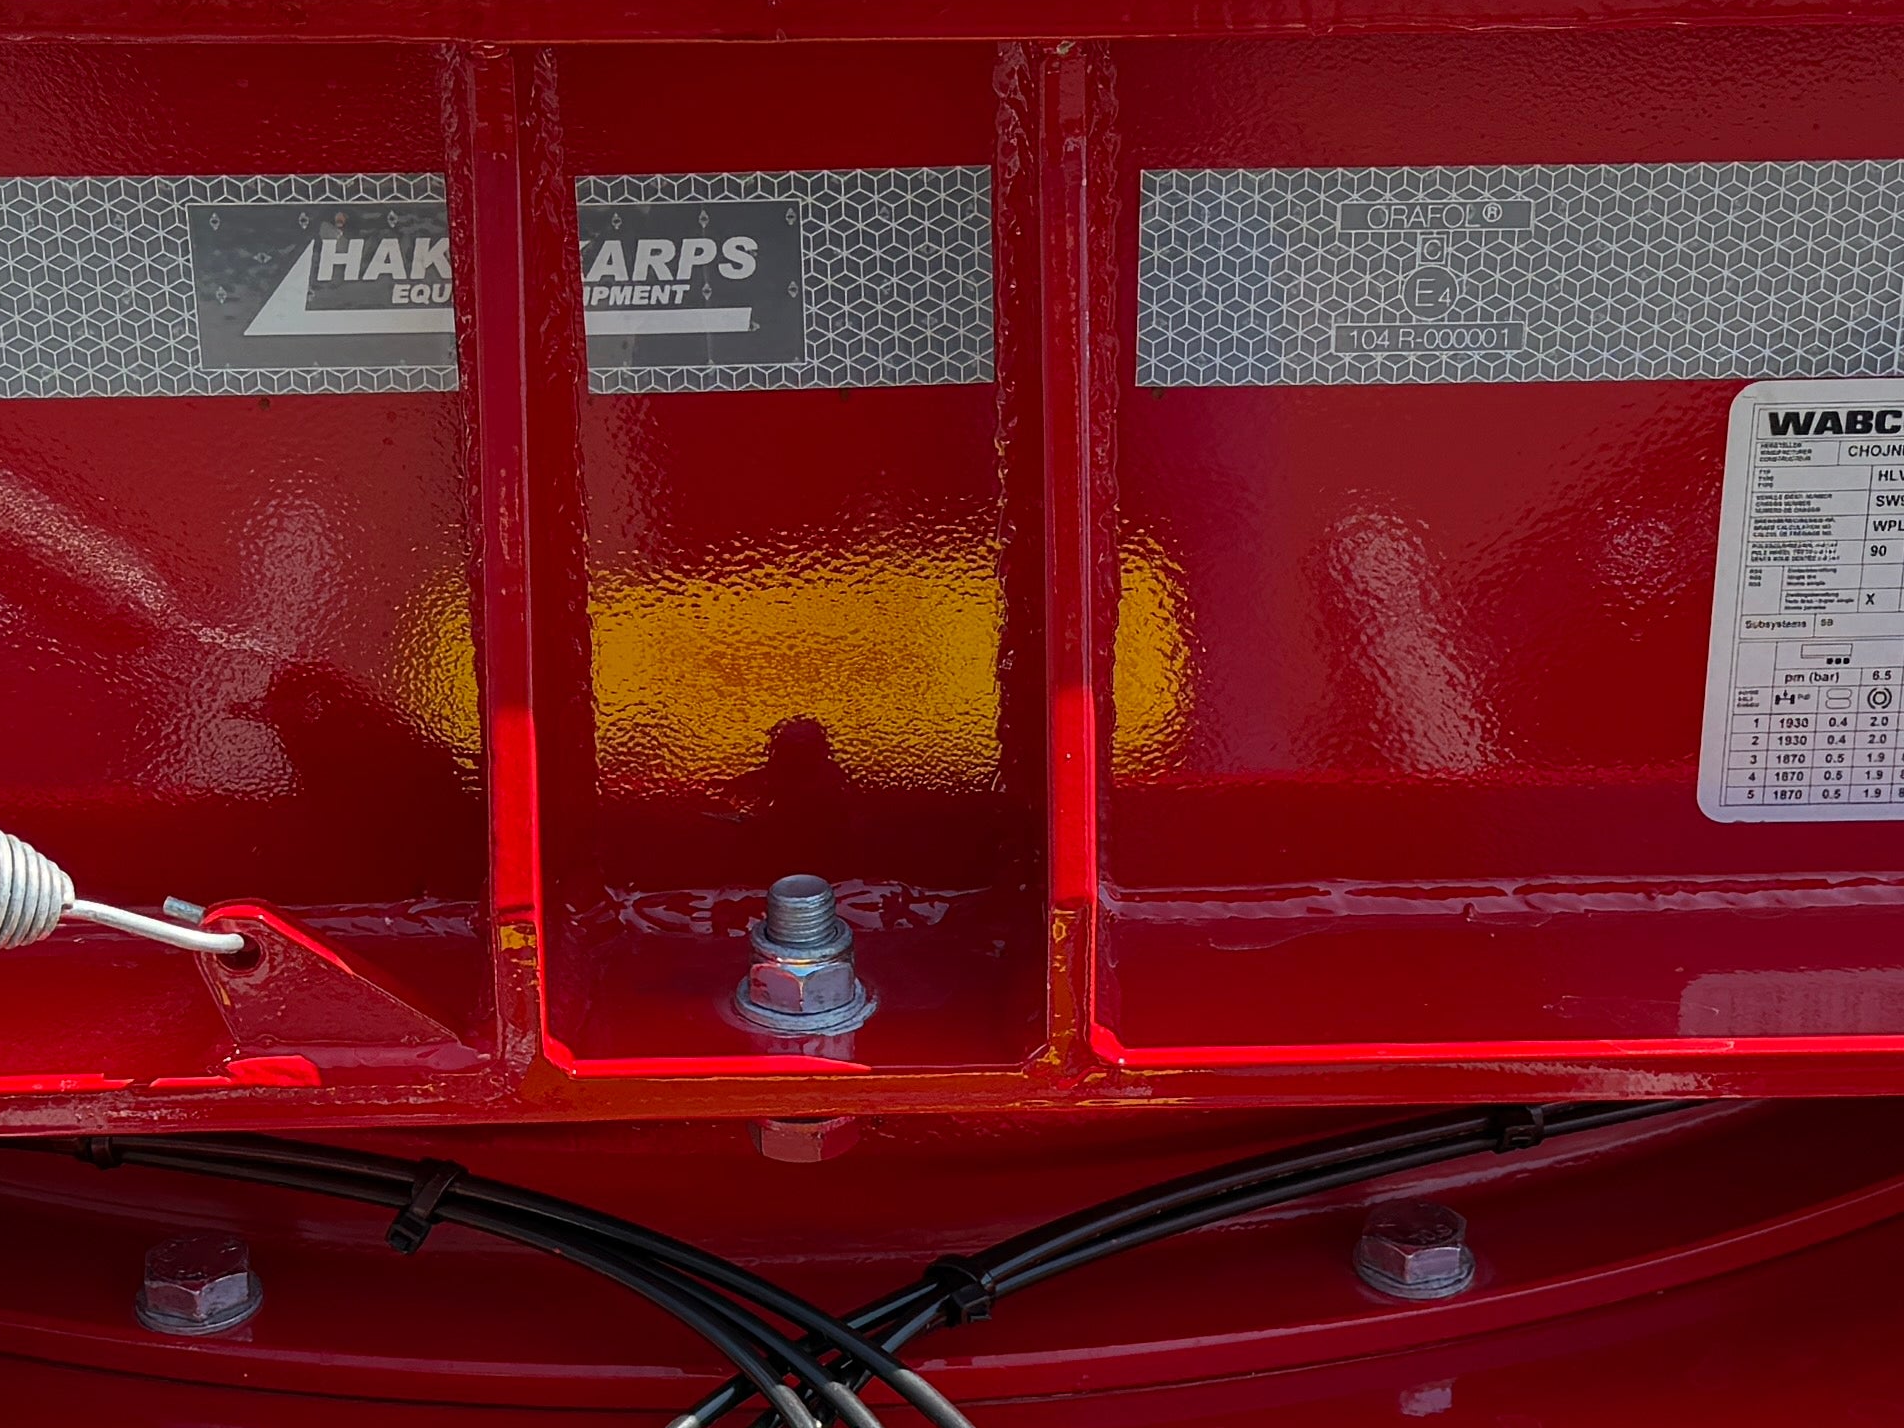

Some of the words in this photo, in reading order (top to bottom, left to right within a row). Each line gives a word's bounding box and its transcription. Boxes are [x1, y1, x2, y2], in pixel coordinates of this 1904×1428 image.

[580, 236, 758, 282] ARPS
[1424, 239, 1442, 260] C
[1349, 329, 1390, 349] 104
[1399, 328, 1509, 349] R-000001
[1870, 545, 1888, 557] 90
[1808, 671, 1840, 684] (bar)
